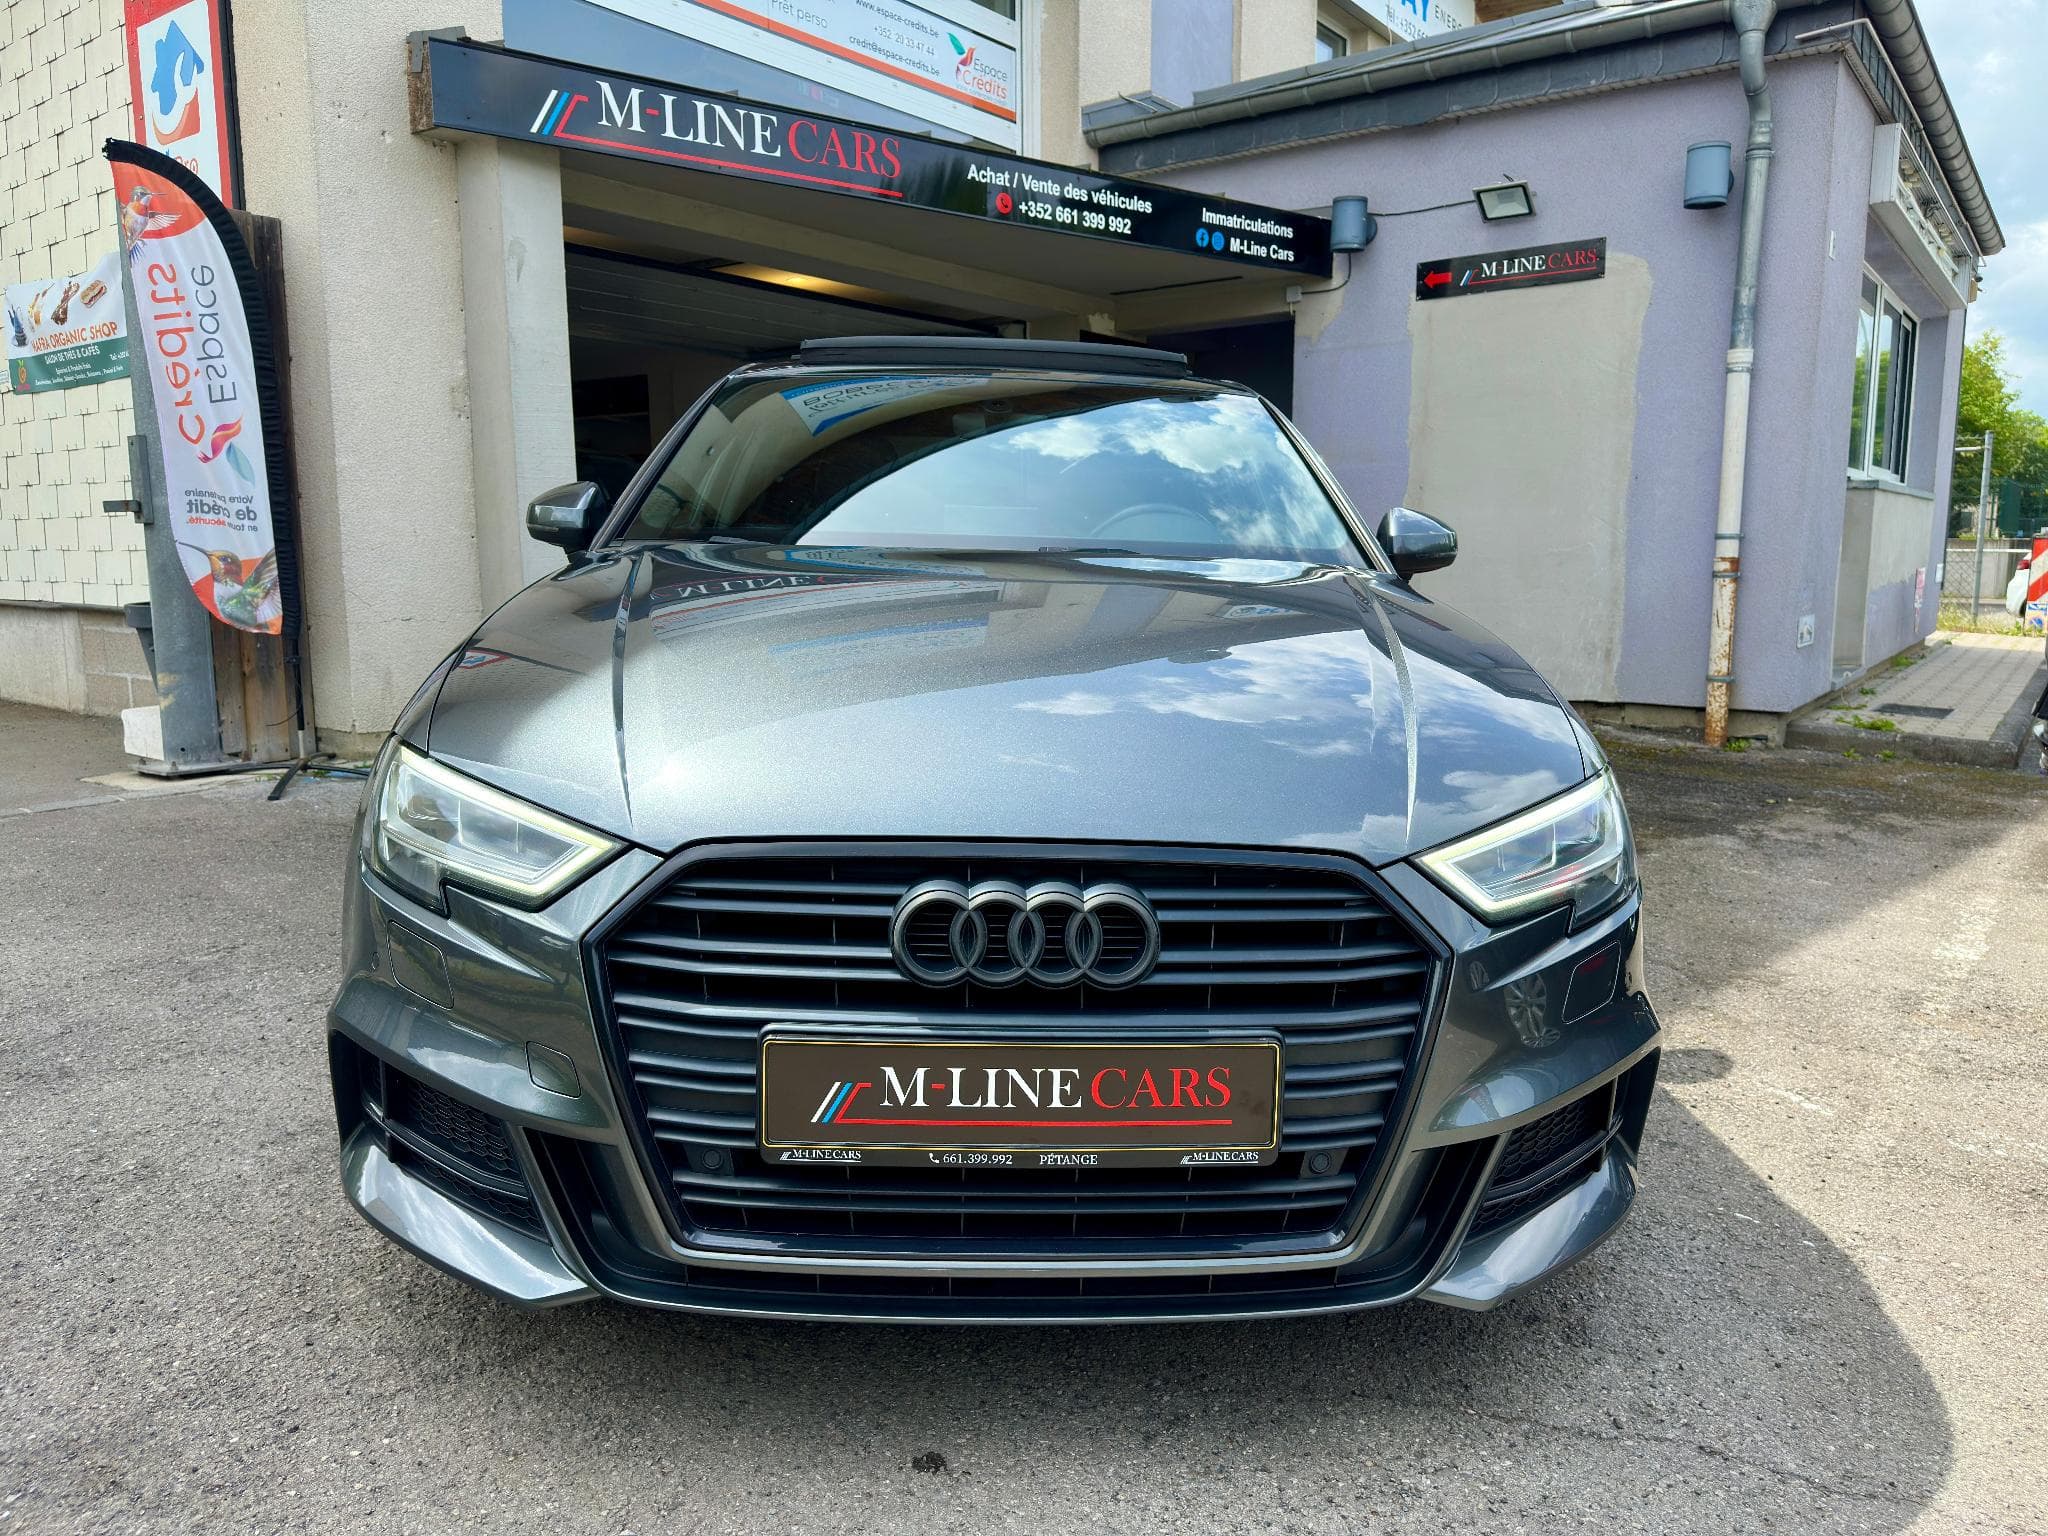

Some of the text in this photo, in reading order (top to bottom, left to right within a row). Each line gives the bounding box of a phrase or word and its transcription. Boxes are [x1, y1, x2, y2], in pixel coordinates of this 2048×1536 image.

[771, 0, 828, 29] Prêt perso
[849, 35, 940, 76] credit@espace-credits.be
[973, 58, 1009, 82] Espace
[962, 69, 1008, 100] Crédits
[596, 80, 900, 179] M-LINE CARS
[967, 163, 1010, 188] Achat
[1021, 173, 1060, 196] Vente
[1064, 181, 1088, 202] des
[1091, 189, 1153, 214] véhicules
[1019, 201, 1132, 234] +352 661 399 992
[1202, 207, 1293, 238] Immatriculations
[1229, 237, 1294, 262] M-Line Cars
[1481, 247, 1598, 278] M-LINE CARS
[49, 327, 87, 349] ORGANIC
[89, 321, 118, 340] SHOP
[879, 1066, 1231, 1108] M-LINE CARS
[832, 1150, 862, 1160] CARS
[943, 1153, 1013, 1165] 661.399.992
[1040, 1153, 1098, 1165] PÉTANGE
[1232, 1151, 1259, 1161] CARS
